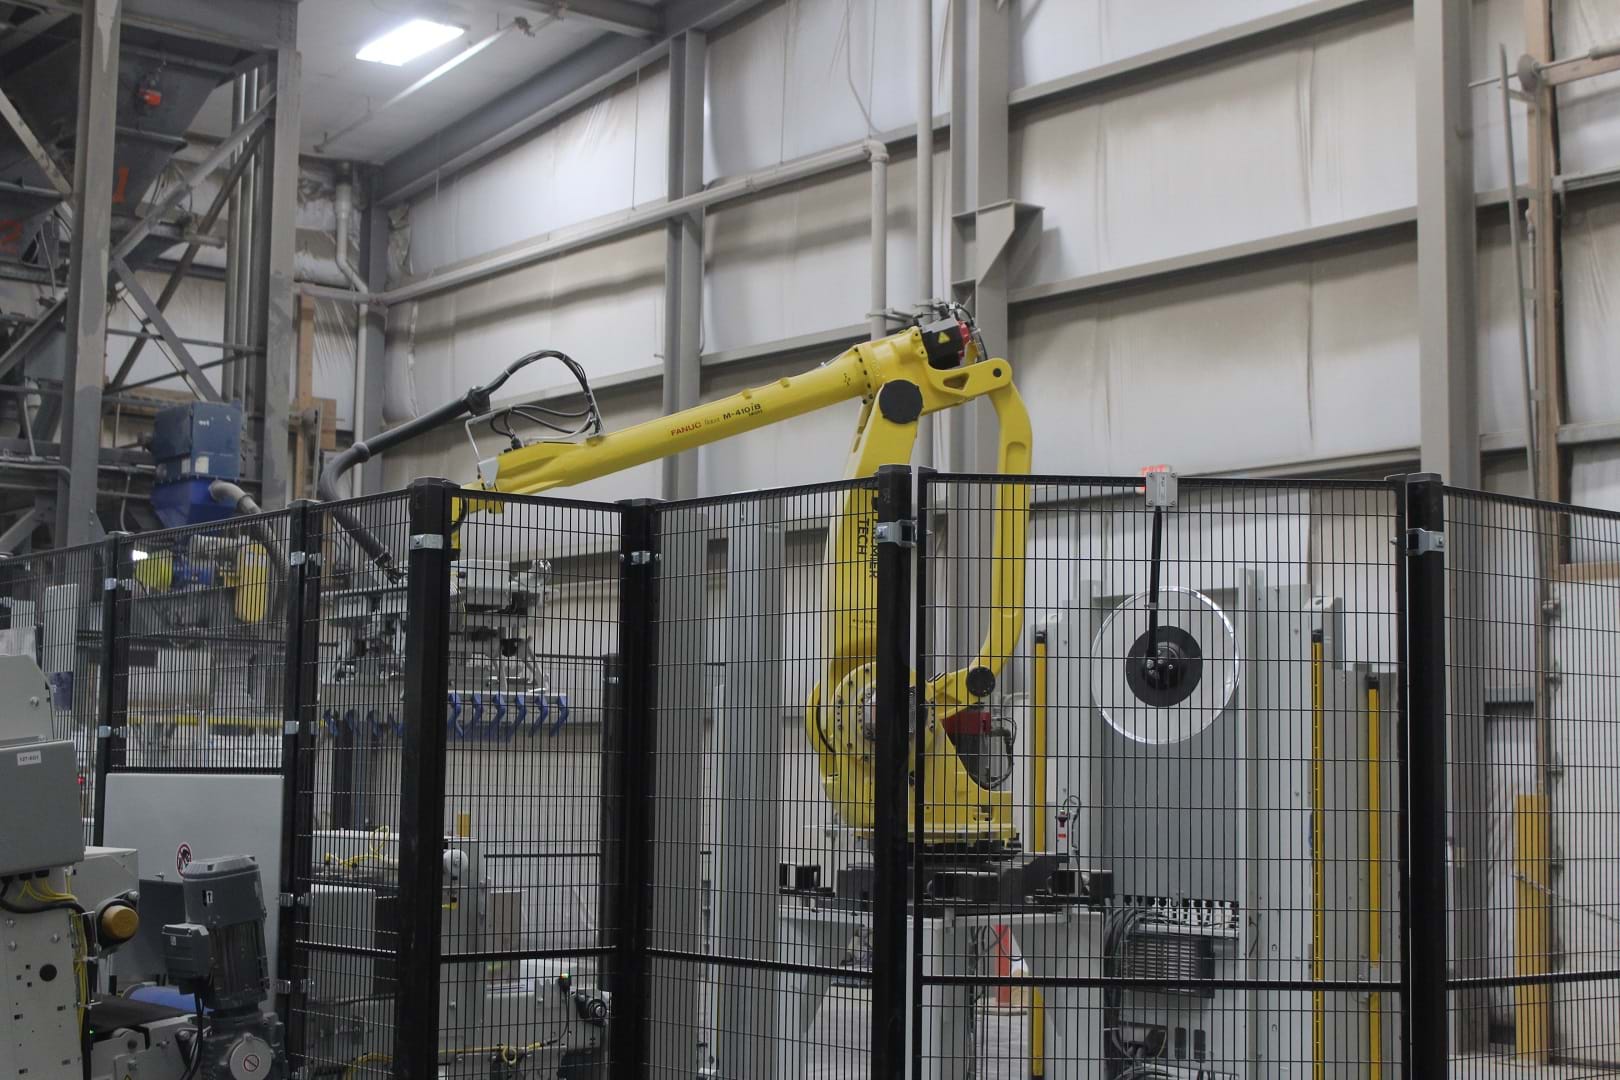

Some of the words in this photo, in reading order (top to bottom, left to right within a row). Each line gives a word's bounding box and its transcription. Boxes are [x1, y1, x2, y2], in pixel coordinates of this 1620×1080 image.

[112, 167, 128, 203] 1
[0, 219, 23, 254] 2
[671, 422, 701, 436] FANUC
[858, 518, 870, 555] TECH
